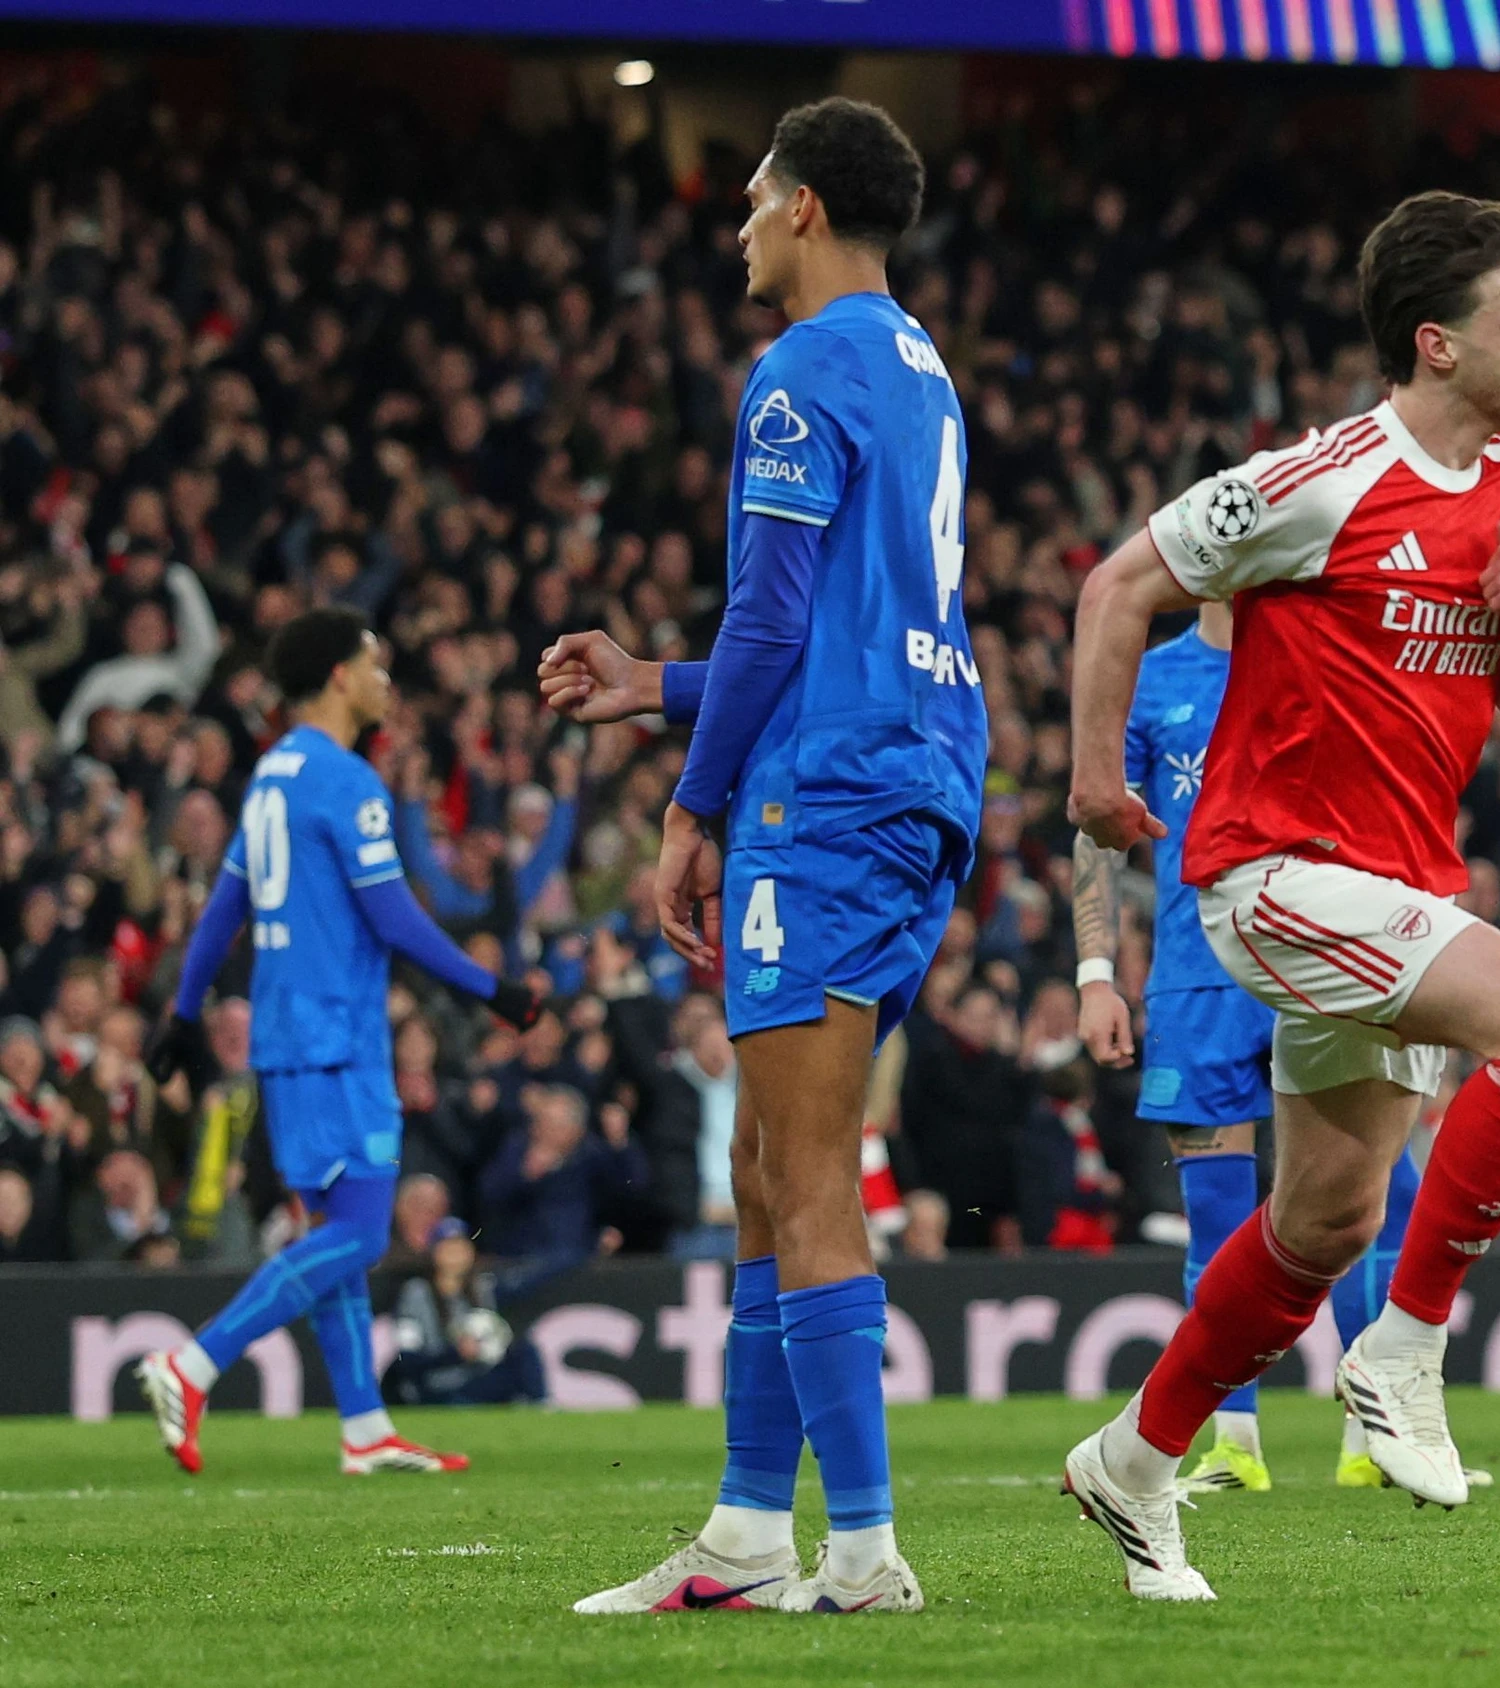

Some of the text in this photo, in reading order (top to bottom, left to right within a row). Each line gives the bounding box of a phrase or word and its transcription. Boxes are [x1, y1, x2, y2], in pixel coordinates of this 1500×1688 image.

[929, 415, 965, 623] 4
[1394, 638, 1439, 674] FLY
[741, 878, 785, 962] 4
